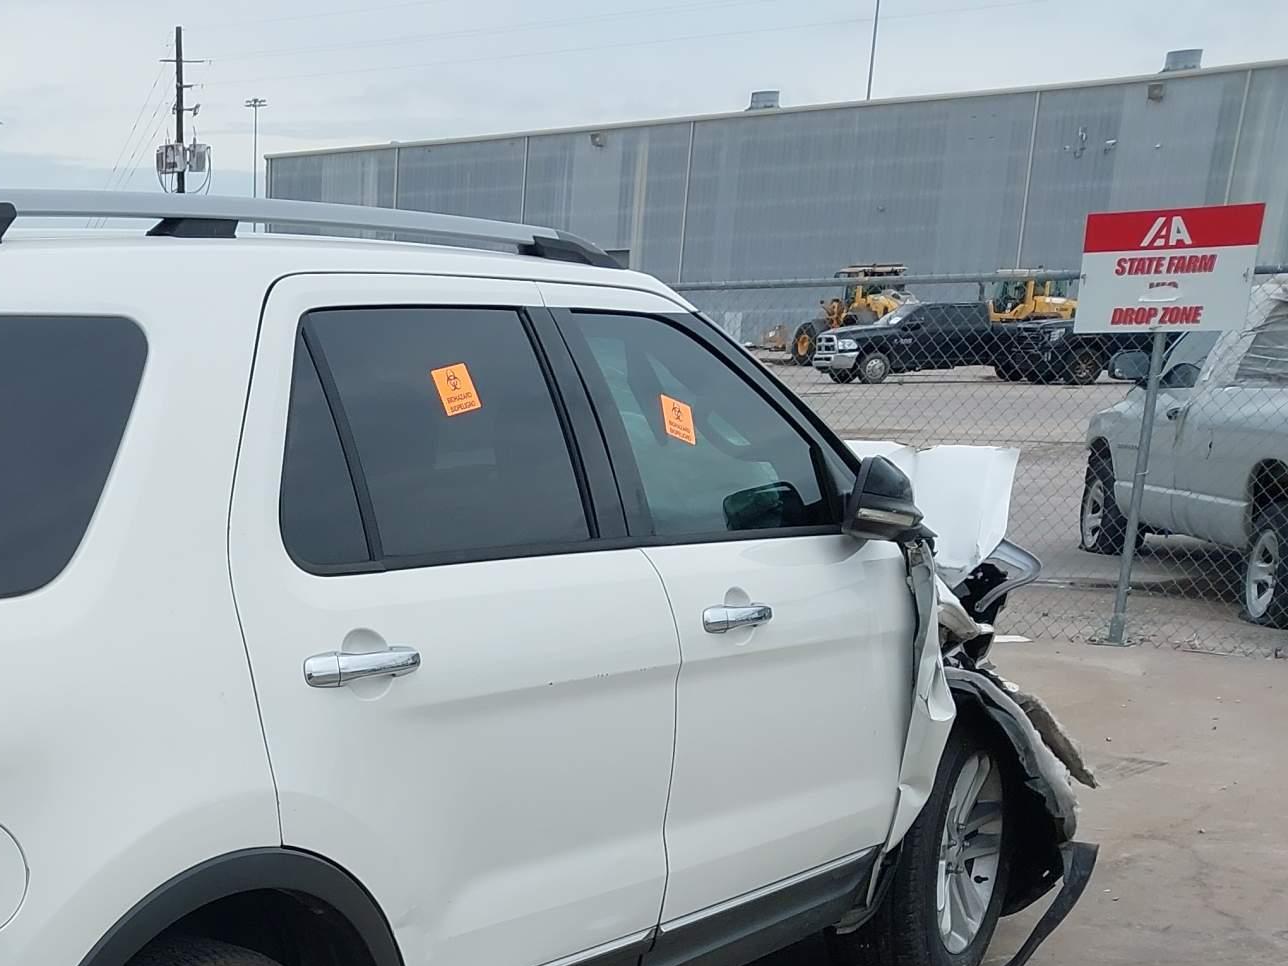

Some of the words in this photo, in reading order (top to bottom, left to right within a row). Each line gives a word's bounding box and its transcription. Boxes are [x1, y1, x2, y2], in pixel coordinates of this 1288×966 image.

[1115, 256, 1166, 276] STATE
[1166, 254, 1218, 274] FARM
[1110, 306, 1159, 325] DROP
[1158, 305, 1204, 325] ZONE
